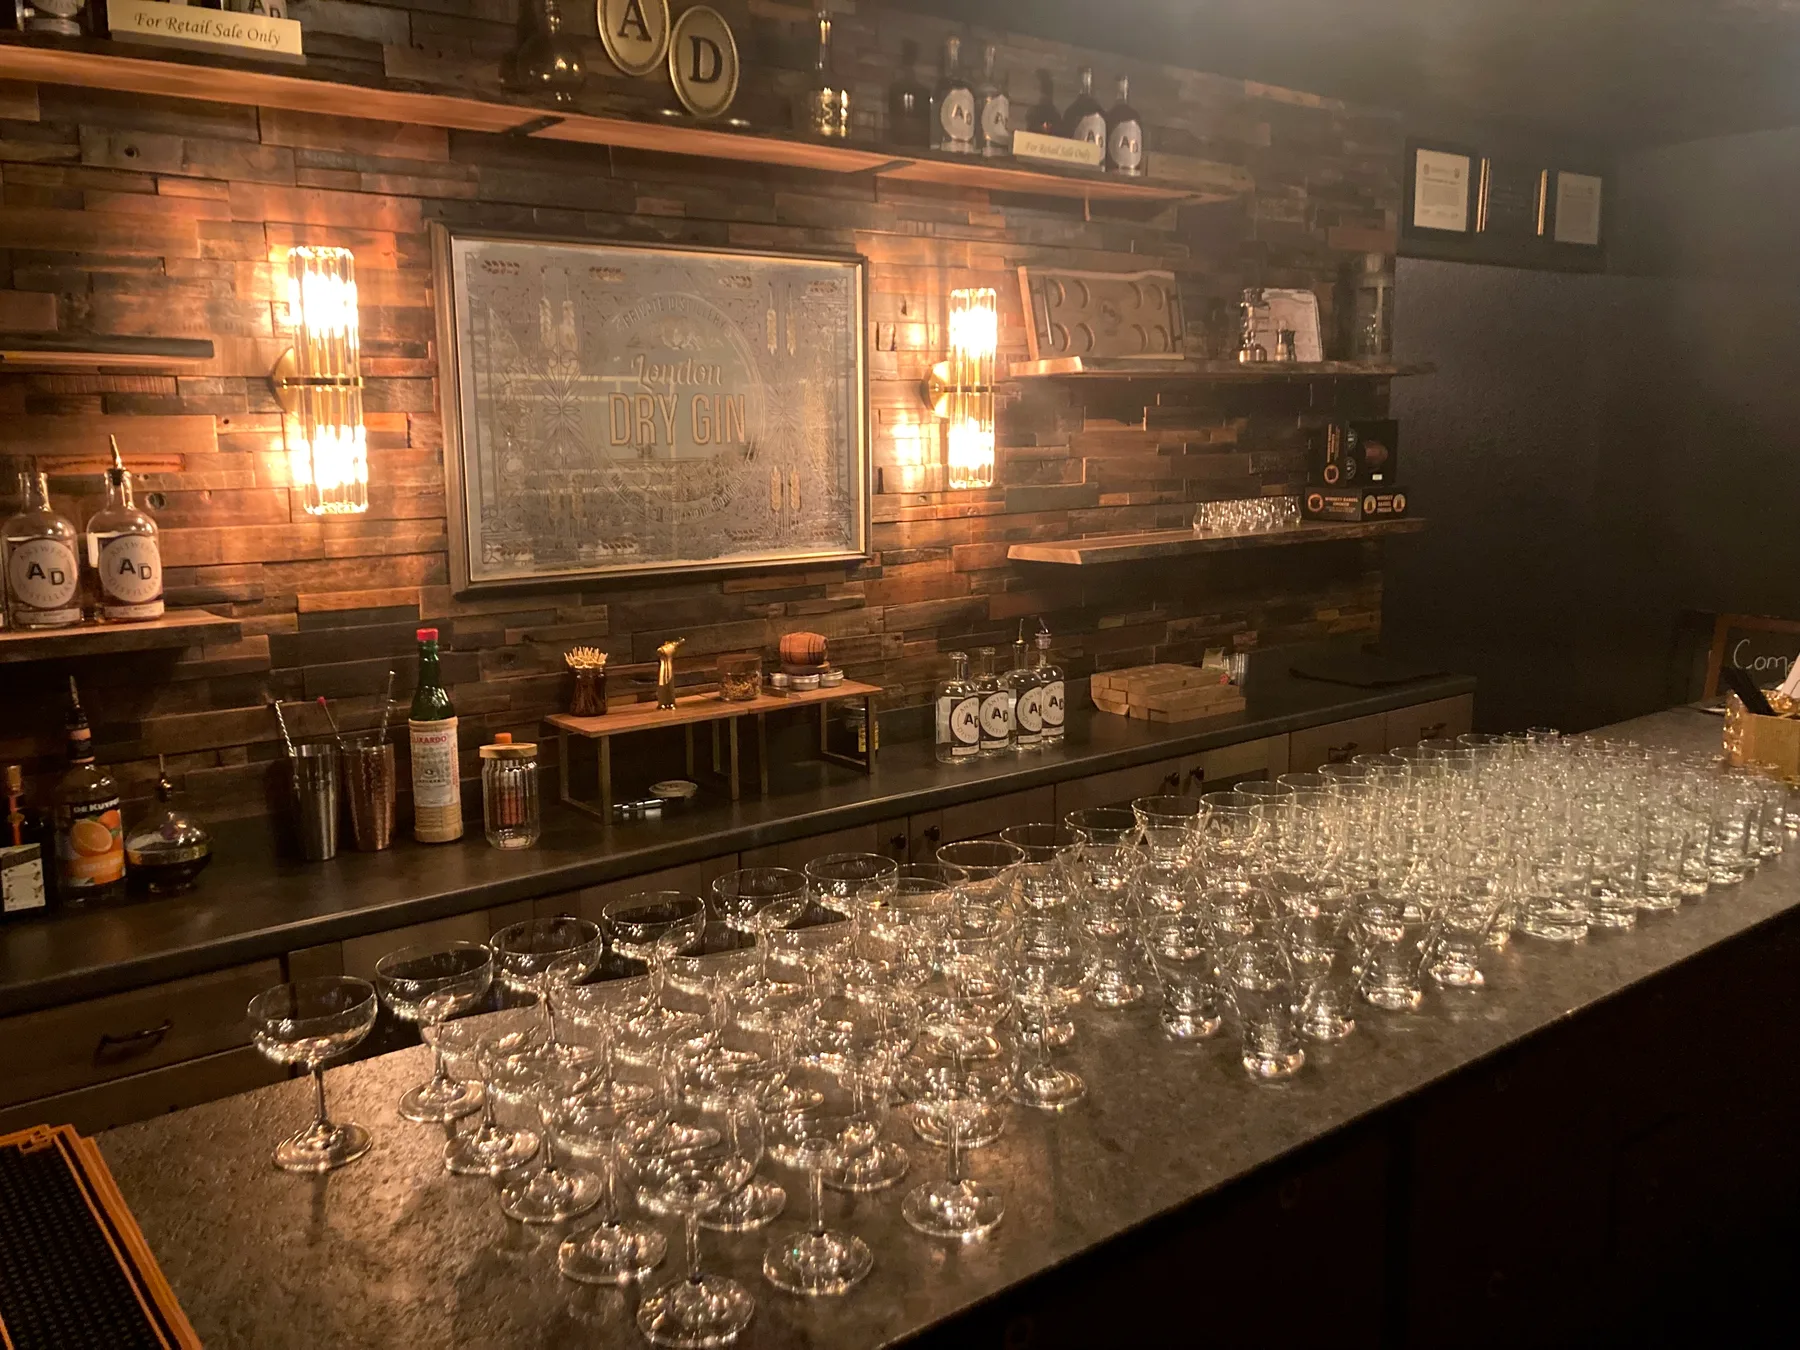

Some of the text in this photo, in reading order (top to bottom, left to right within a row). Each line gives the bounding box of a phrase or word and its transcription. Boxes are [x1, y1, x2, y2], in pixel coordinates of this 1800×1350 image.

[134, 12, 281, 49] For Retail Sale Only
[617, 0, 652, 42] A
[688, 35, 723, 84] D
[622, 296, 665, 329] PRIVATE
[630, 353, 722, 394] London
[607, 392, 746, 446] DRY GIN
[26, 561, 65, 587] AD
[119, 557, 153, 580] AD
[991, 706, 1009, 723] AD
